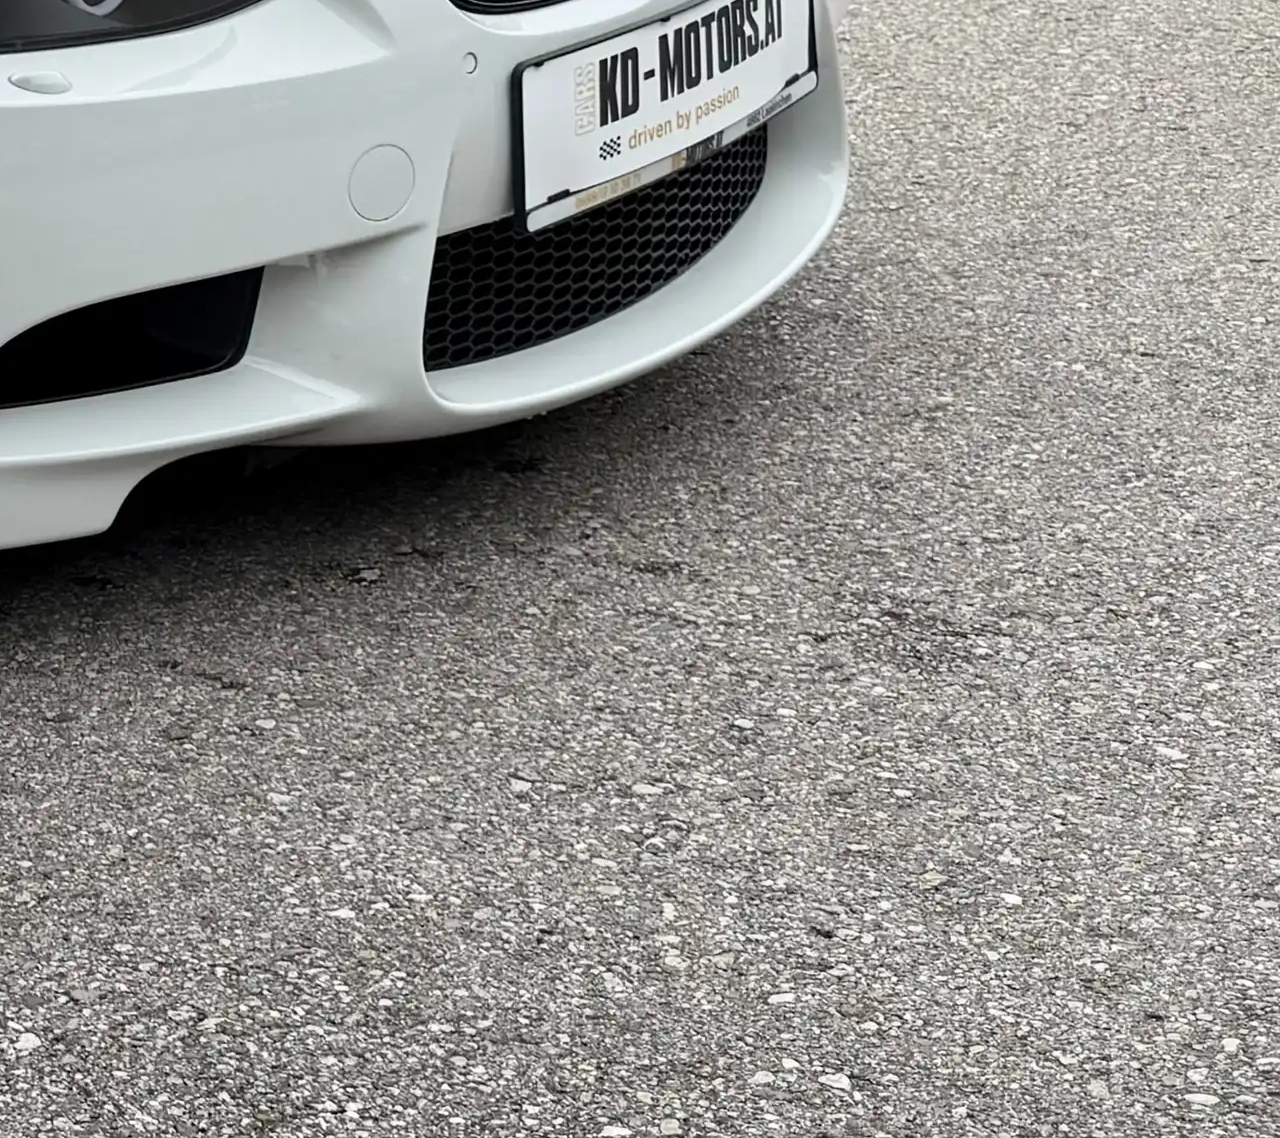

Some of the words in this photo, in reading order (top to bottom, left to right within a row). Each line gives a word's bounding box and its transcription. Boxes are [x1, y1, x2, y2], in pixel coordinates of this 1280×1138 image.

[573, 62, 596, 137] CARS
[627, 117, 673, 150] driven
[676, 109, 692, 134] by
[695, 85, 740, 124] passion
